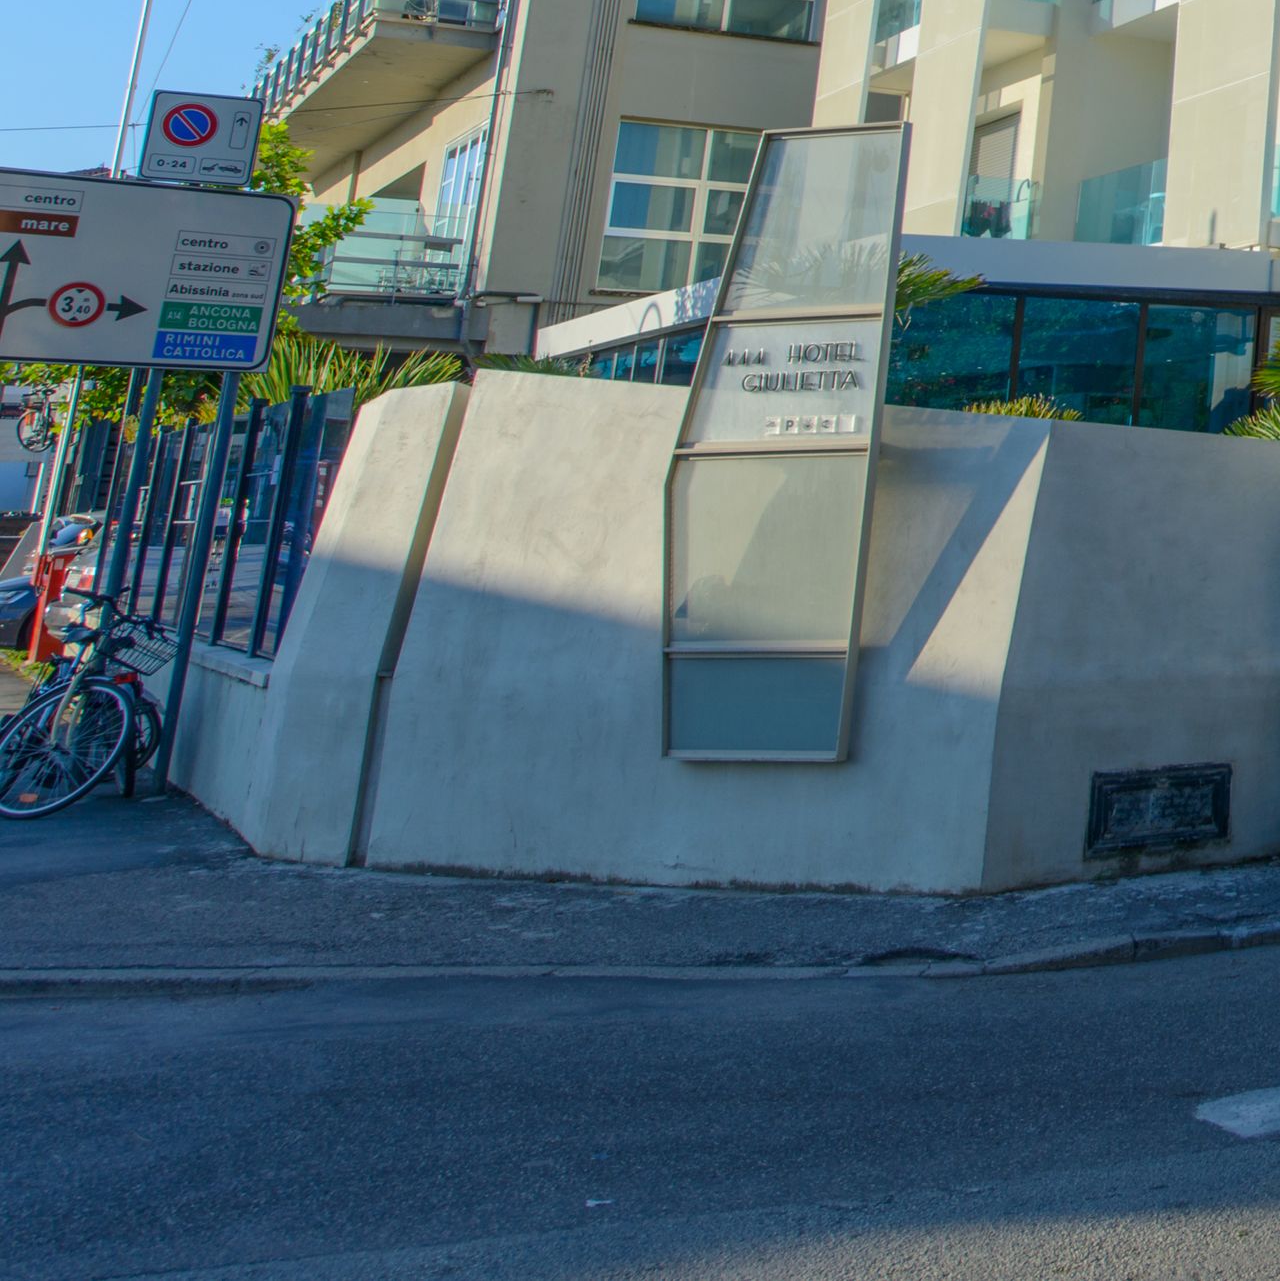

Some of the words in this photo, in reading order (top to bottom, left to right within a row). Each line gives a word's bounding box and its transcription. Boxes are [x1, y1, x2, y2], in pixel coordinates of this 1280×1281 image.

[25, 194, 76, 206] centro
[21, 219, 70, 231] mare
[181, 238, 229, 249] centro
[178, 261, 240, 274] stazione
[169, 284, 230, 297] Abissinia
[189, 305, 251, 318] ANCONA
[188, 317, 257, 330] BOLOGNA
[165, 333, 220, 346] RIMINI
[163, 345, 245, 359] CATTOLICA
[788, 341, 864, 364] HOTEL
[742, 369, 859, 392] GIULIETTA
